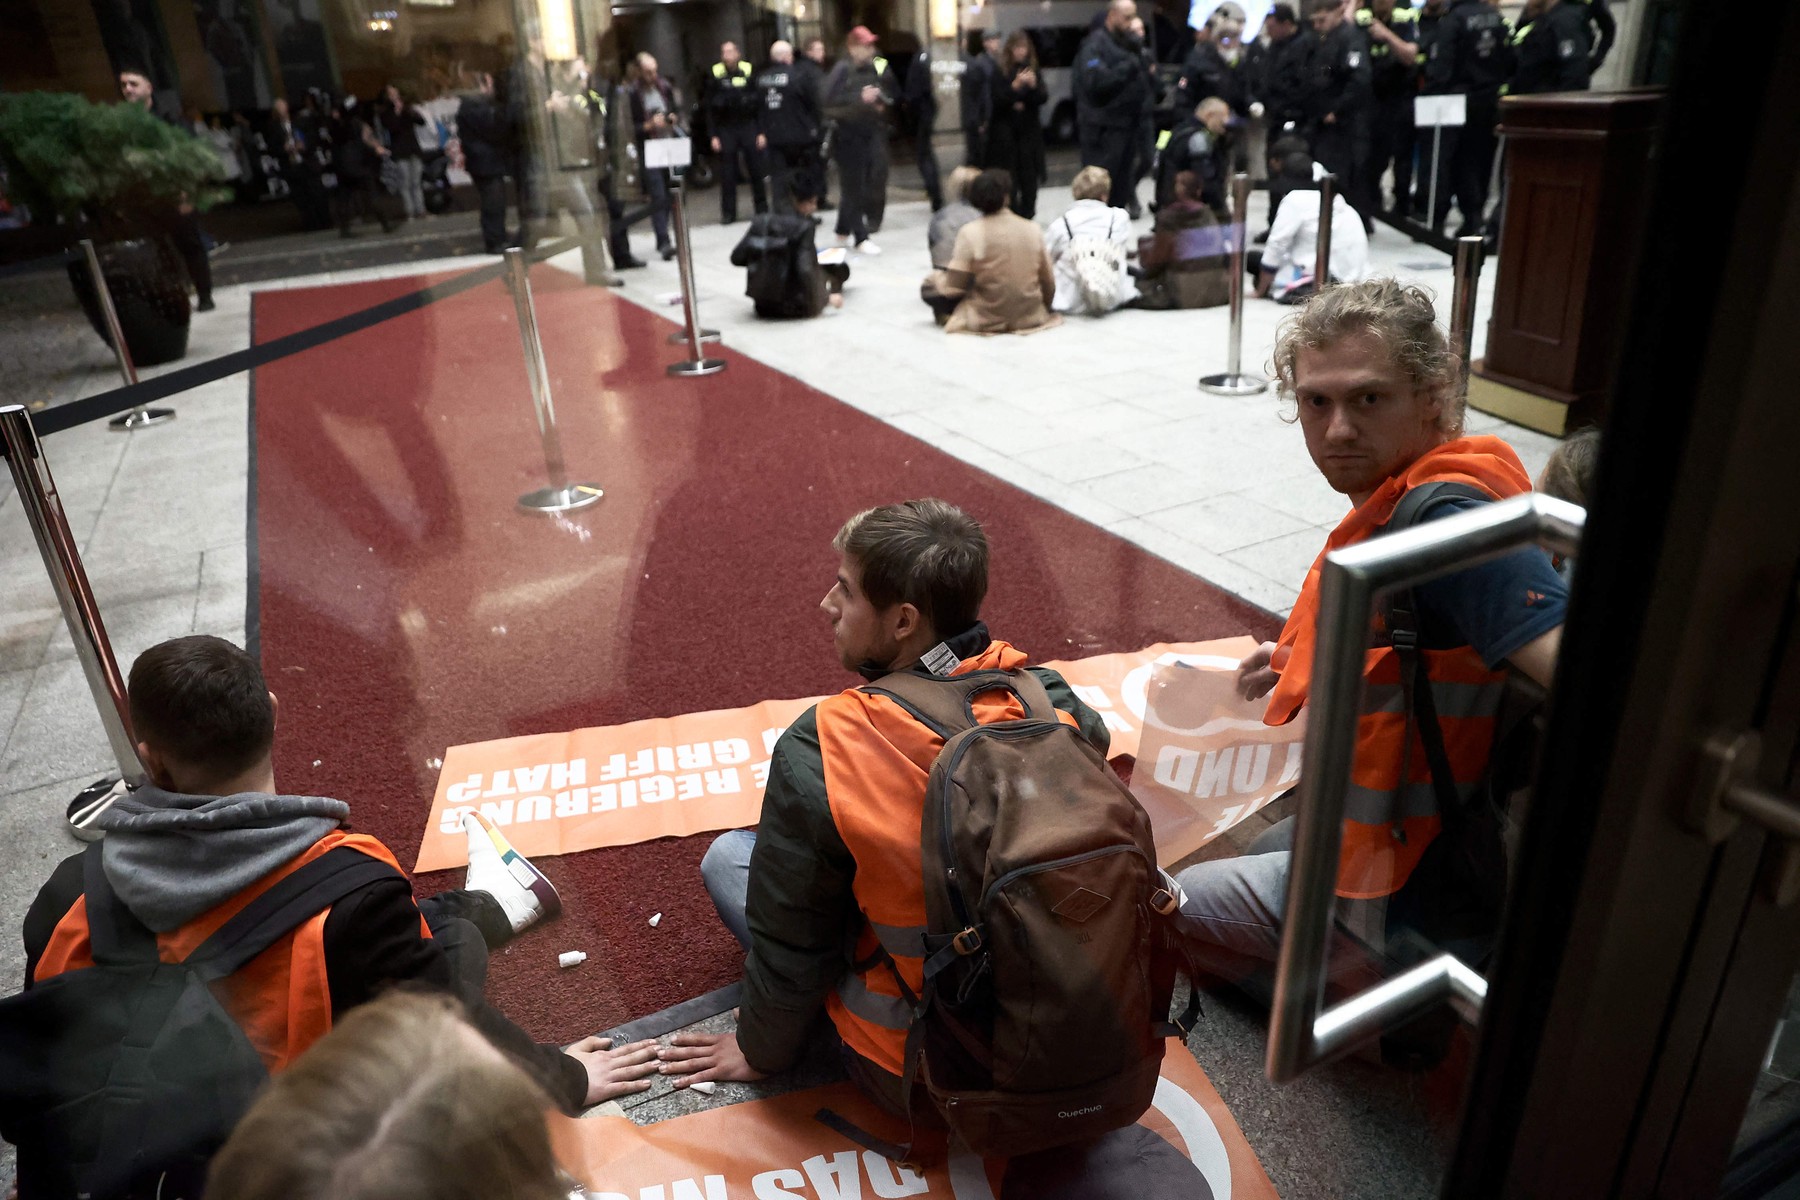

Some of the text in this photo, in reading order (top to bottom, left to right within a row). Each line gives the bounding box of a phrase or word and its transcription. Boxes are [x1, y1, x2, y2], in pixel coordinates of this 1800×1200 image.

[446, 758, 586, 803] HAT?
[601, 738, 751, 780] GRIFF
[440, 768, 741, 834] REGIERUNG
[1057, 1104, 1103, 1119] Quechua
